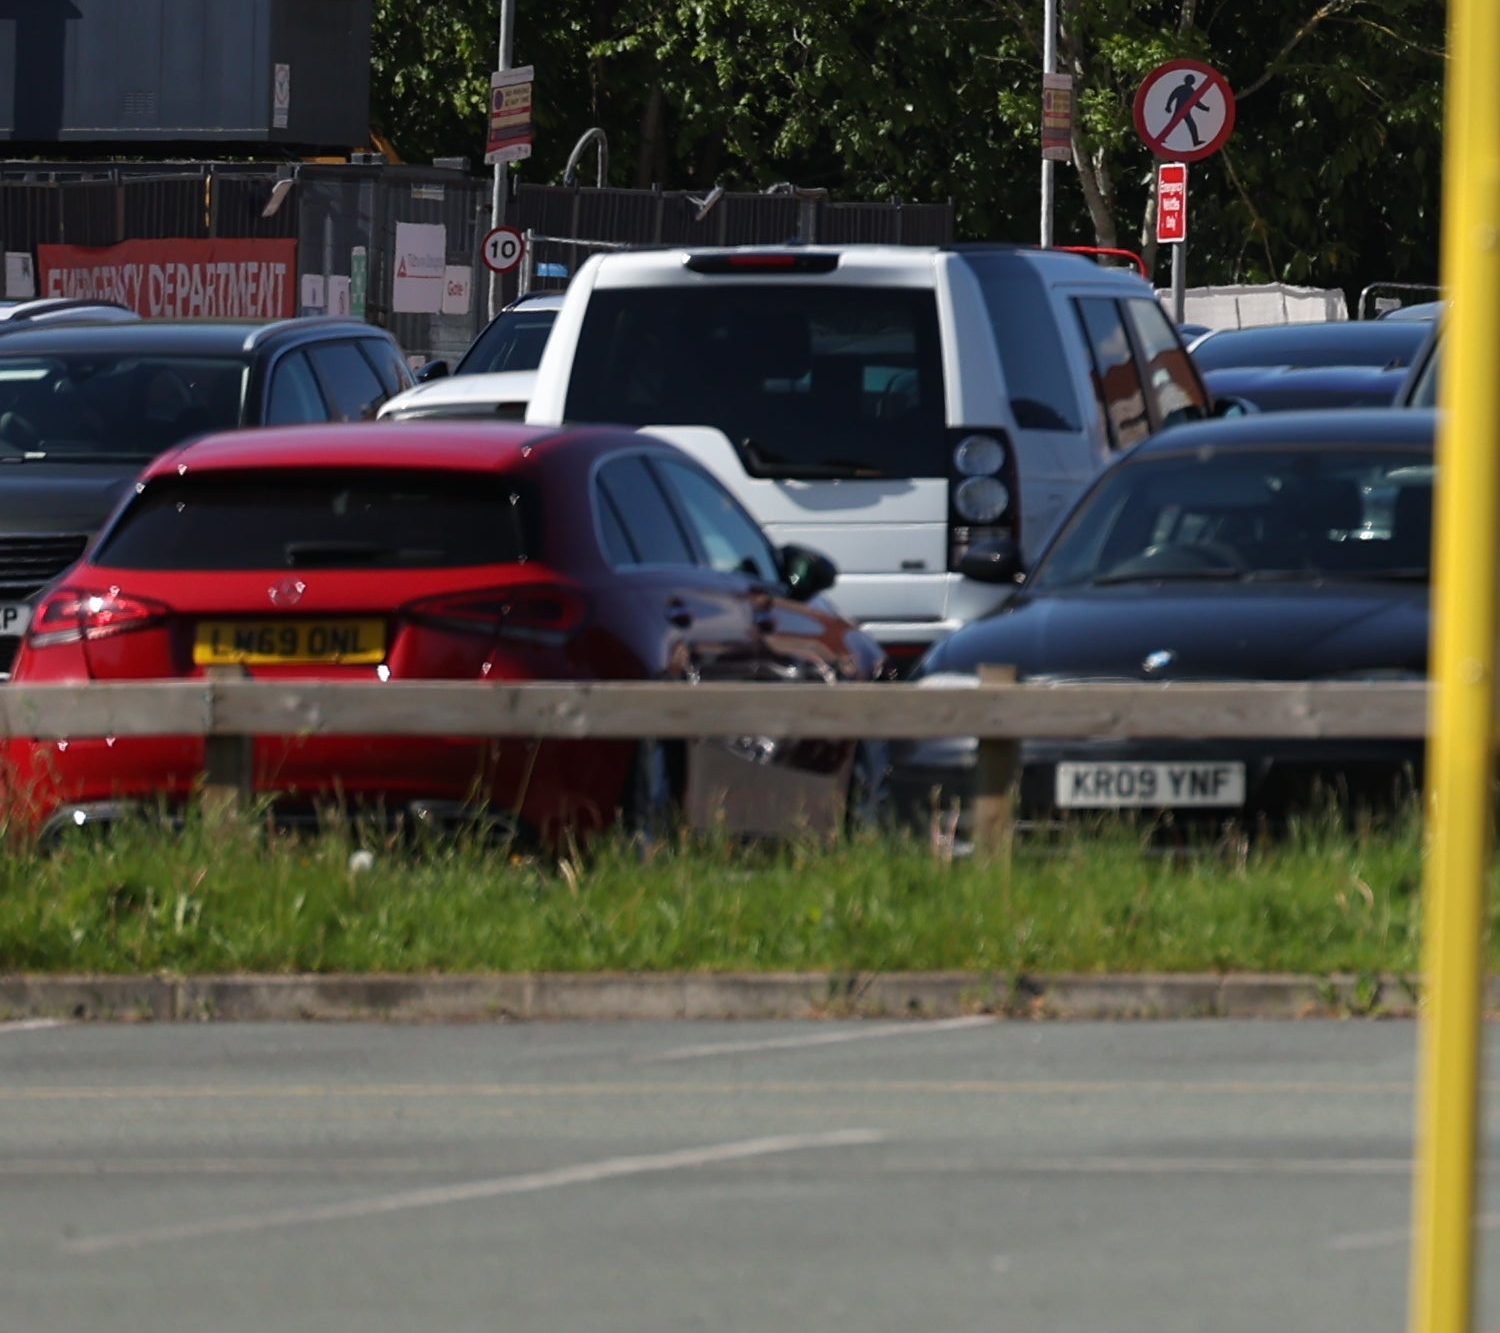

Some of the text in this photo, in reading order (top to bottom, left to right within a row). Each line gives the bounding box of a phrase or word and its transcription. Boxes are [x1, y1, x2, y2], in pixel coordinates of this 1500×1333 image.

[490, 239, 516, 259] 10
[149, 262, 287, 318] DEPARTMENT
[1072, 768, 1234, 798] KR09 YNF
